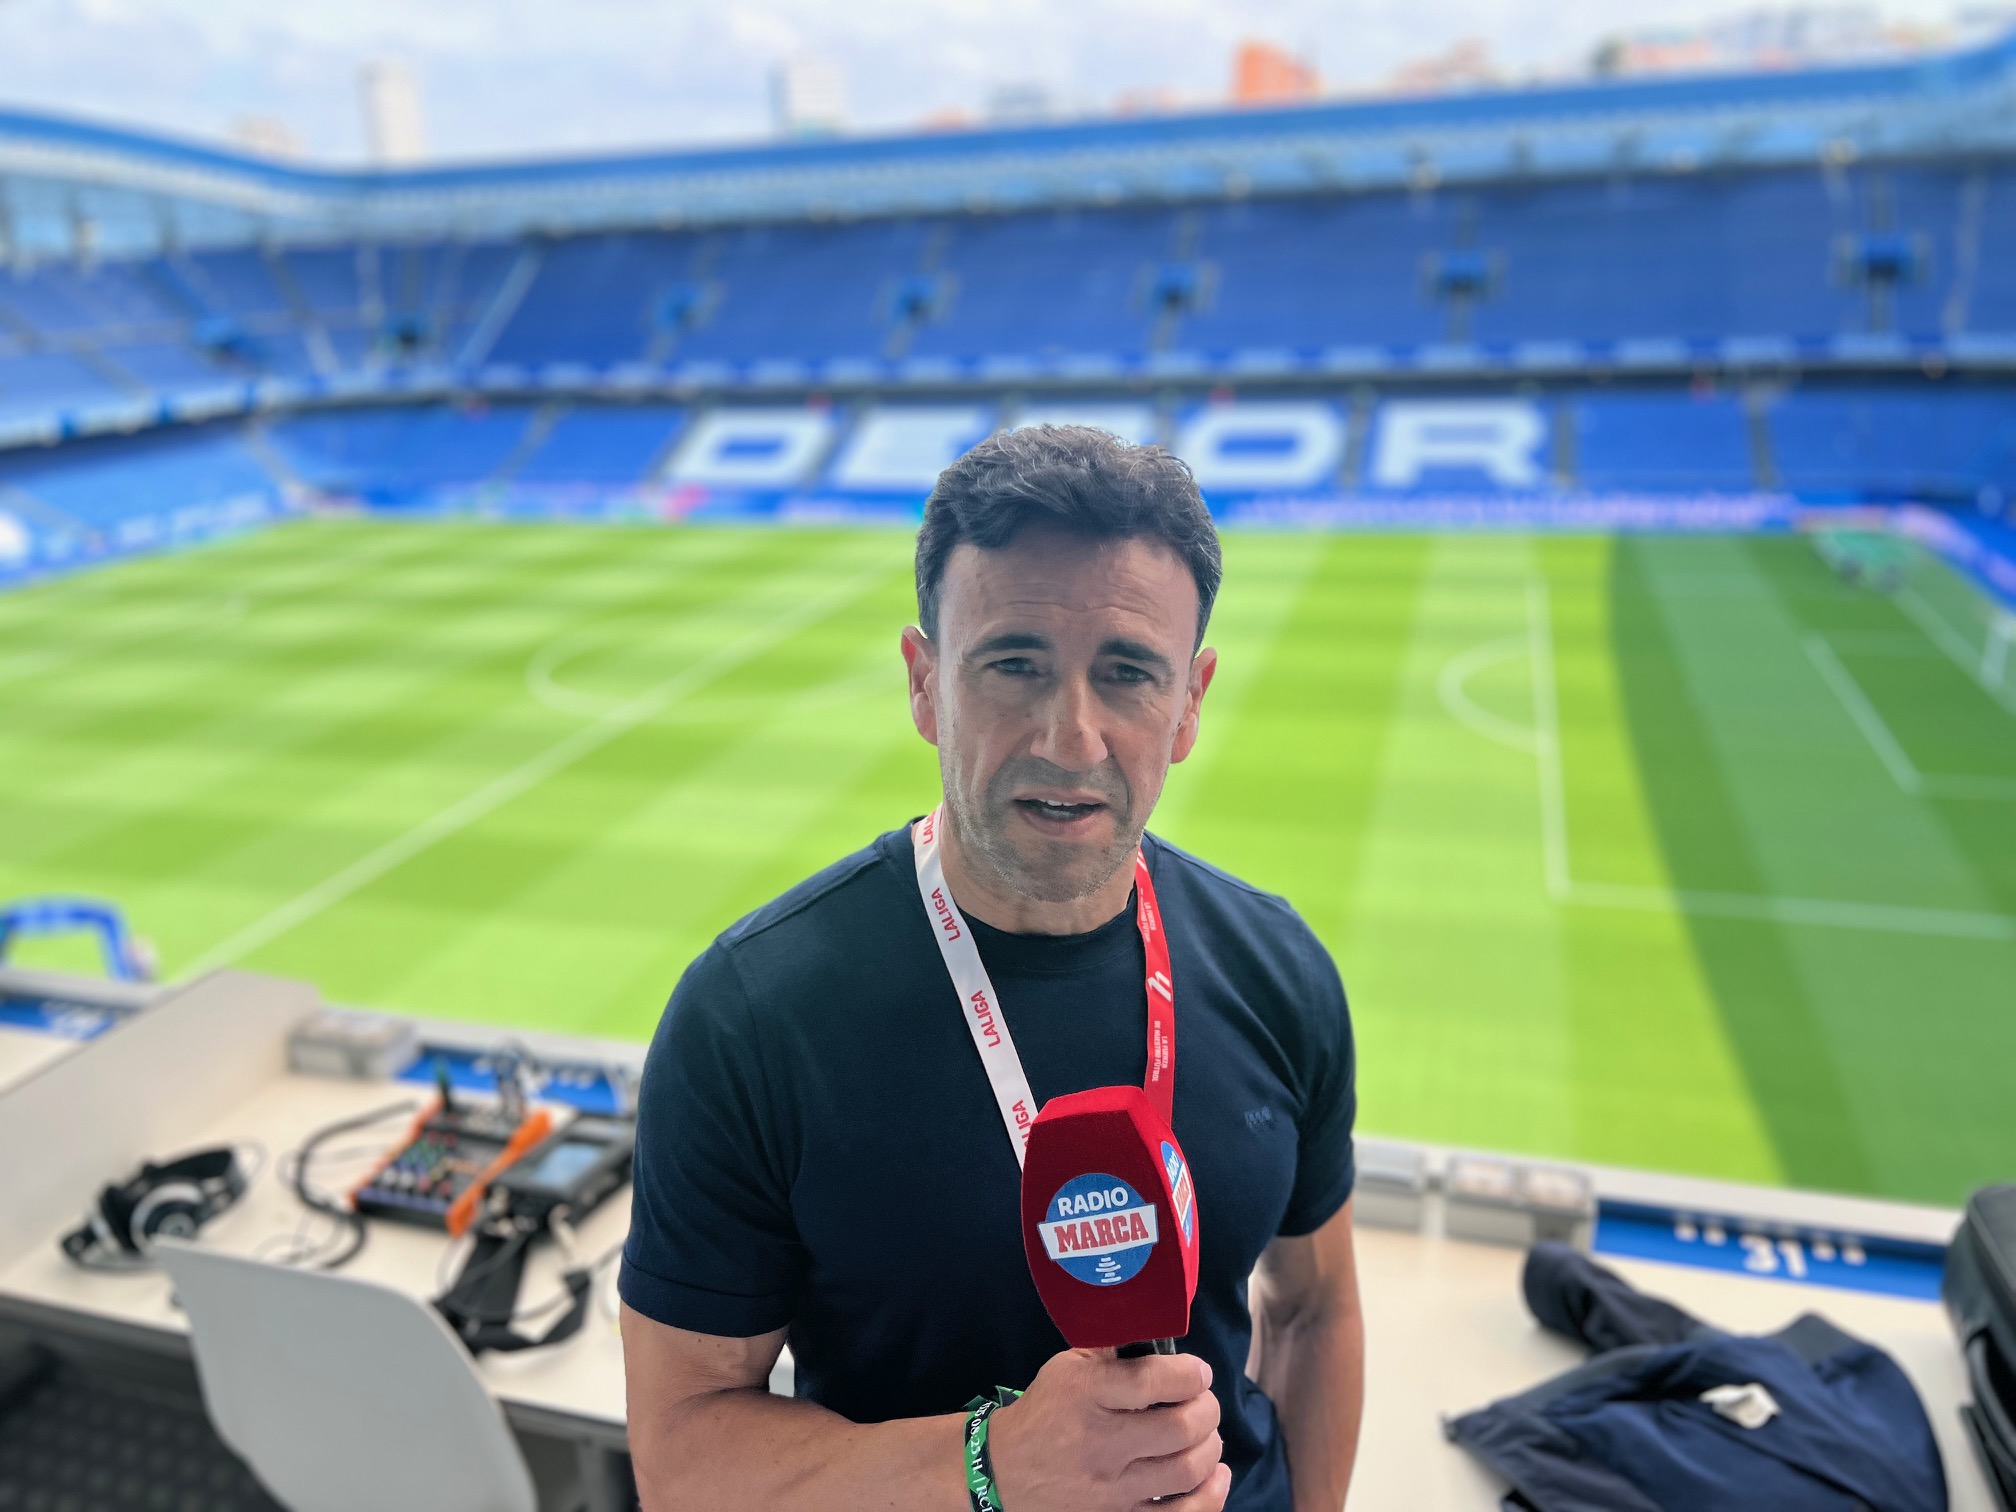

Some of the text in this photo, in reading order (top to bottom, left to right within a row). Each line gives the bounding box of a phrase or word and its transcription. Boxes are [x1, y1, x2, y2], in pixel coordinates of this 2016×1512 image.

[666, 404, 1547, 485] DEOR
[931, 887, 961, 941] LALIGA
[971, 990, 1001, 1047] LALIGA
[1057, 1187, 1128, 1217] RADIO
[1054, 1212, 1149, 1253] MARCA
